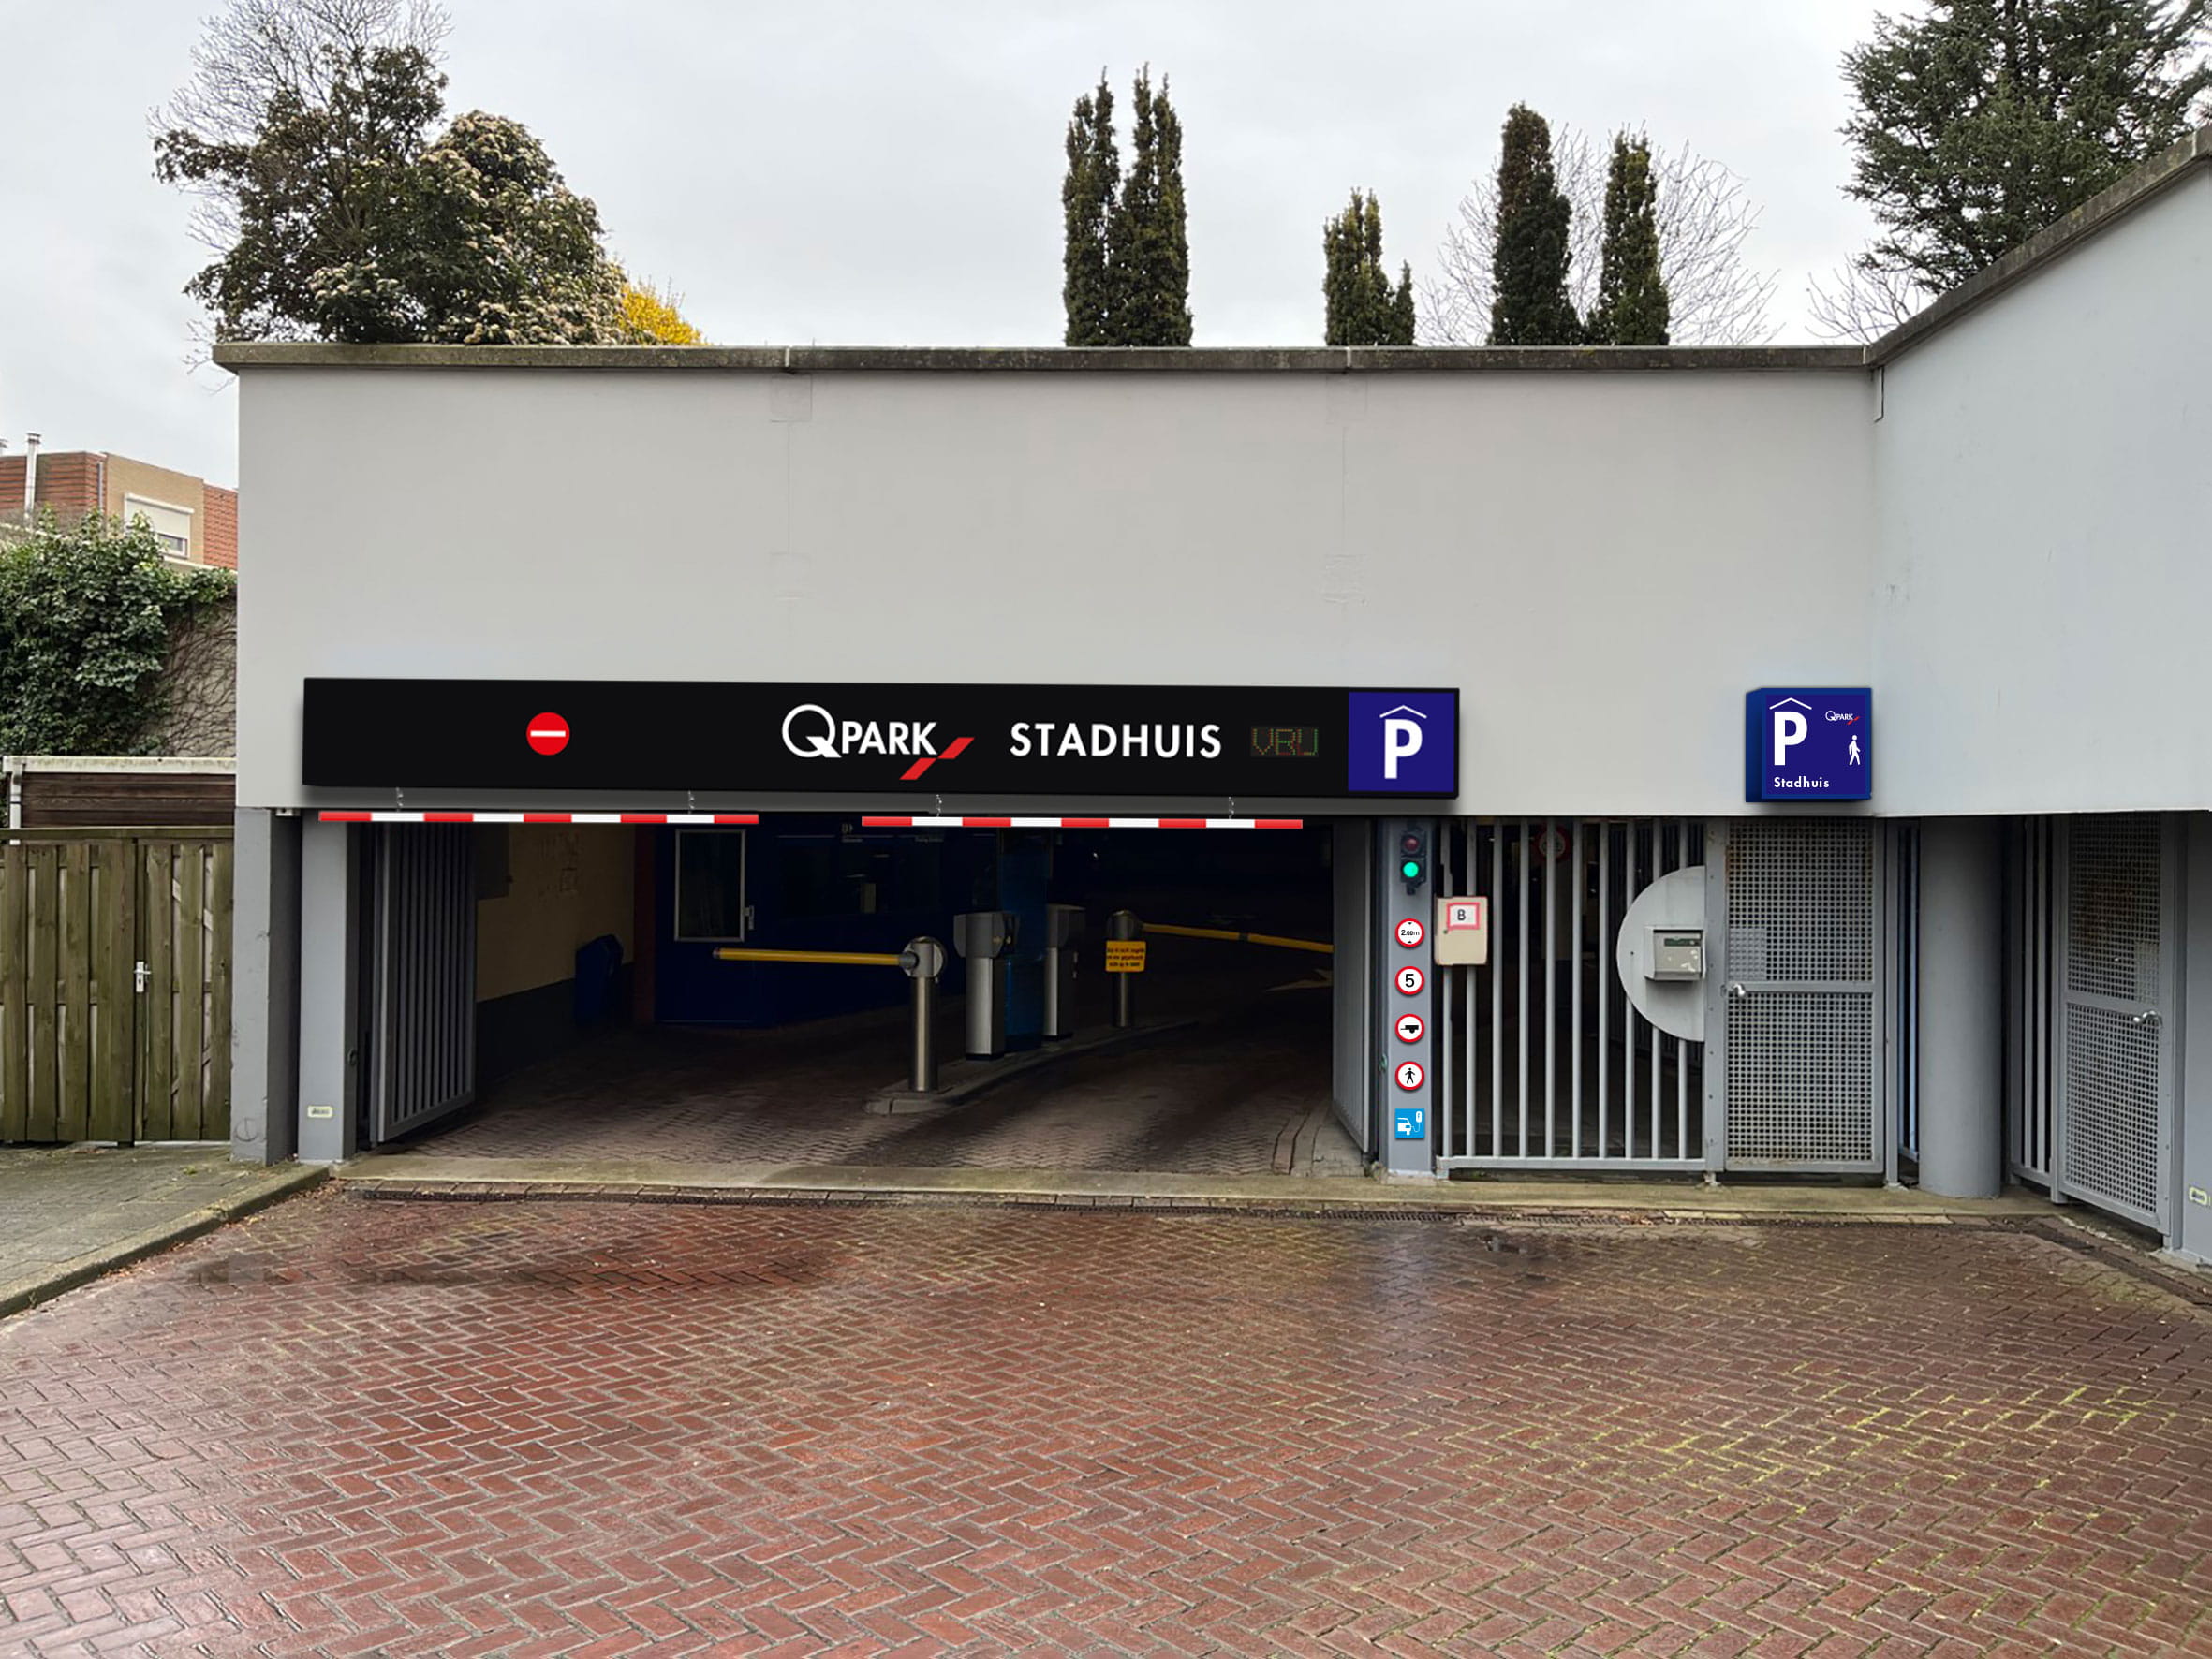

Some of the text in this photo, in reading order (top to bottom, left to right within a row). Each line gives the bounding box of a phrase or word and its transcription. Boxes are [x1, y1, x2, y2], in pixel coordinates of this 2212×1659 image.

[1010, 722, 1221, 758] STADHUIS
[1384, 718, 1423, 779] P
[1774, 711, 1807, 766] P
[1774, 776, 1830, 788] Stadhuis
[1405, 973, 1415, 988] 5
